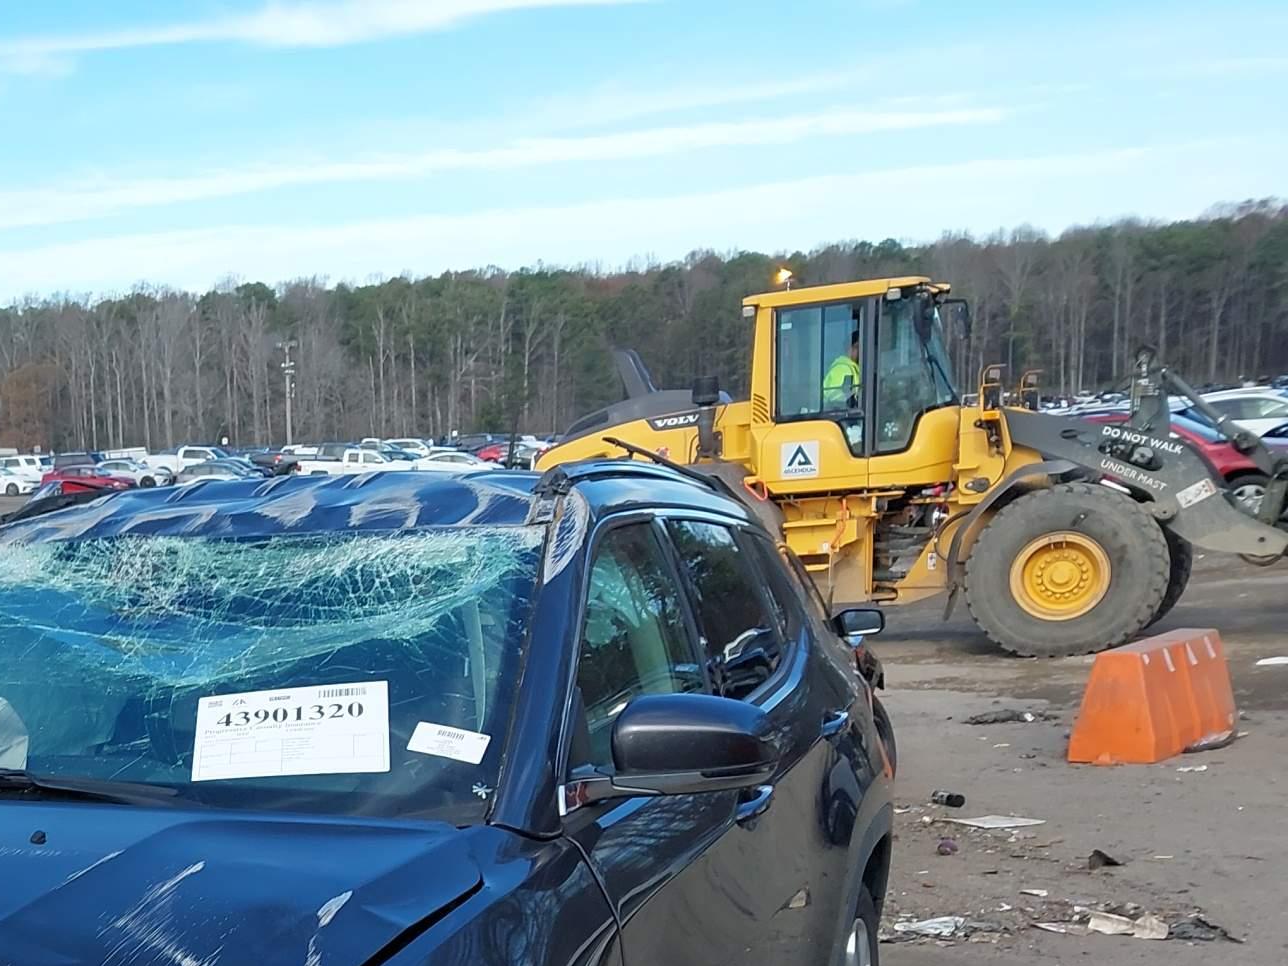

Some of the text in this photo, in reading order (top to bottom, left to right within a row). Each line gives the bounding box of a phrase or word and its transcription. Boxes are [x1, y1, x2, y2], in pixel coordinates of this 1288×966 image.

[654, 414, 699, 427] VOLV
[1102, 426, 1184, 454] DO NOT WALK
[1100, 459, 1167, 490] UNDER MAST
[216, 702, 364, 727] 43901320
